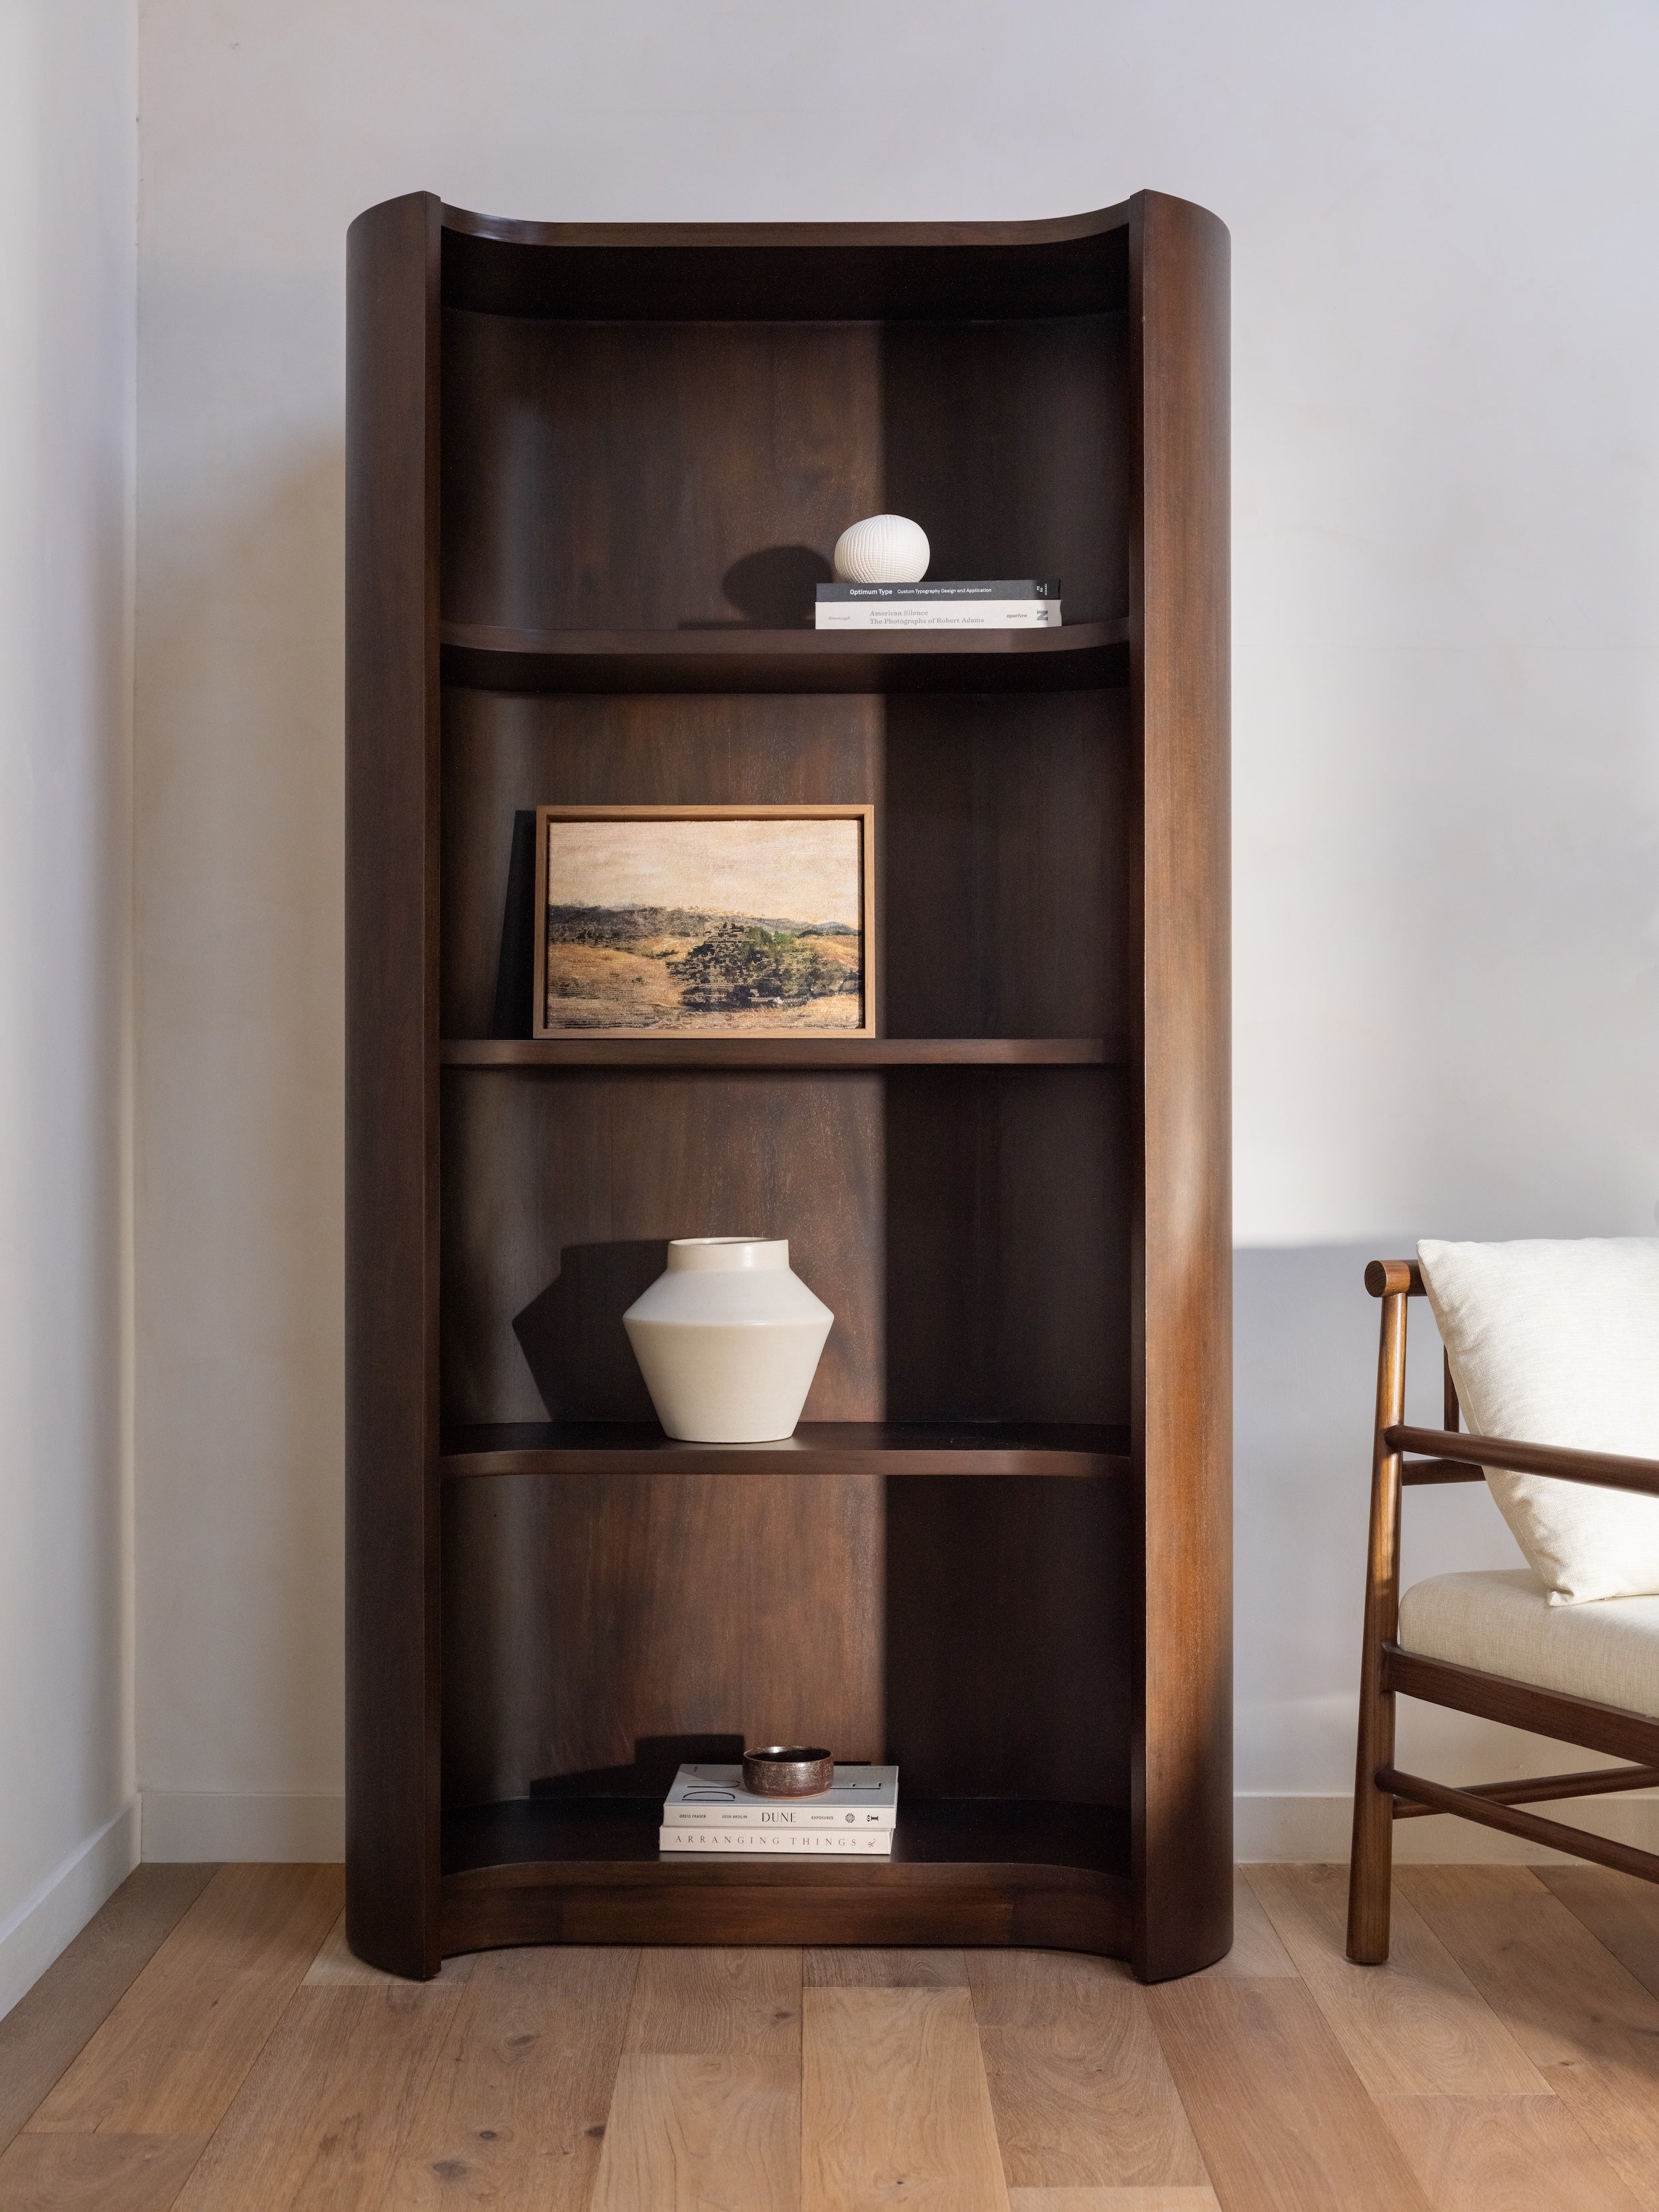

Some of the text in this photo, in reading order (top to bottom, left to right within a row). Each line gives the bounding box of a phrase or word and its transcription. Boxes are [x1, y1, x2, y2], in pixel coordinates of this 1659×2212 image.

[762, 1812, 796, 1823] DUNE
[675, 1835, 857, 1847] ARRANGING THINGS
